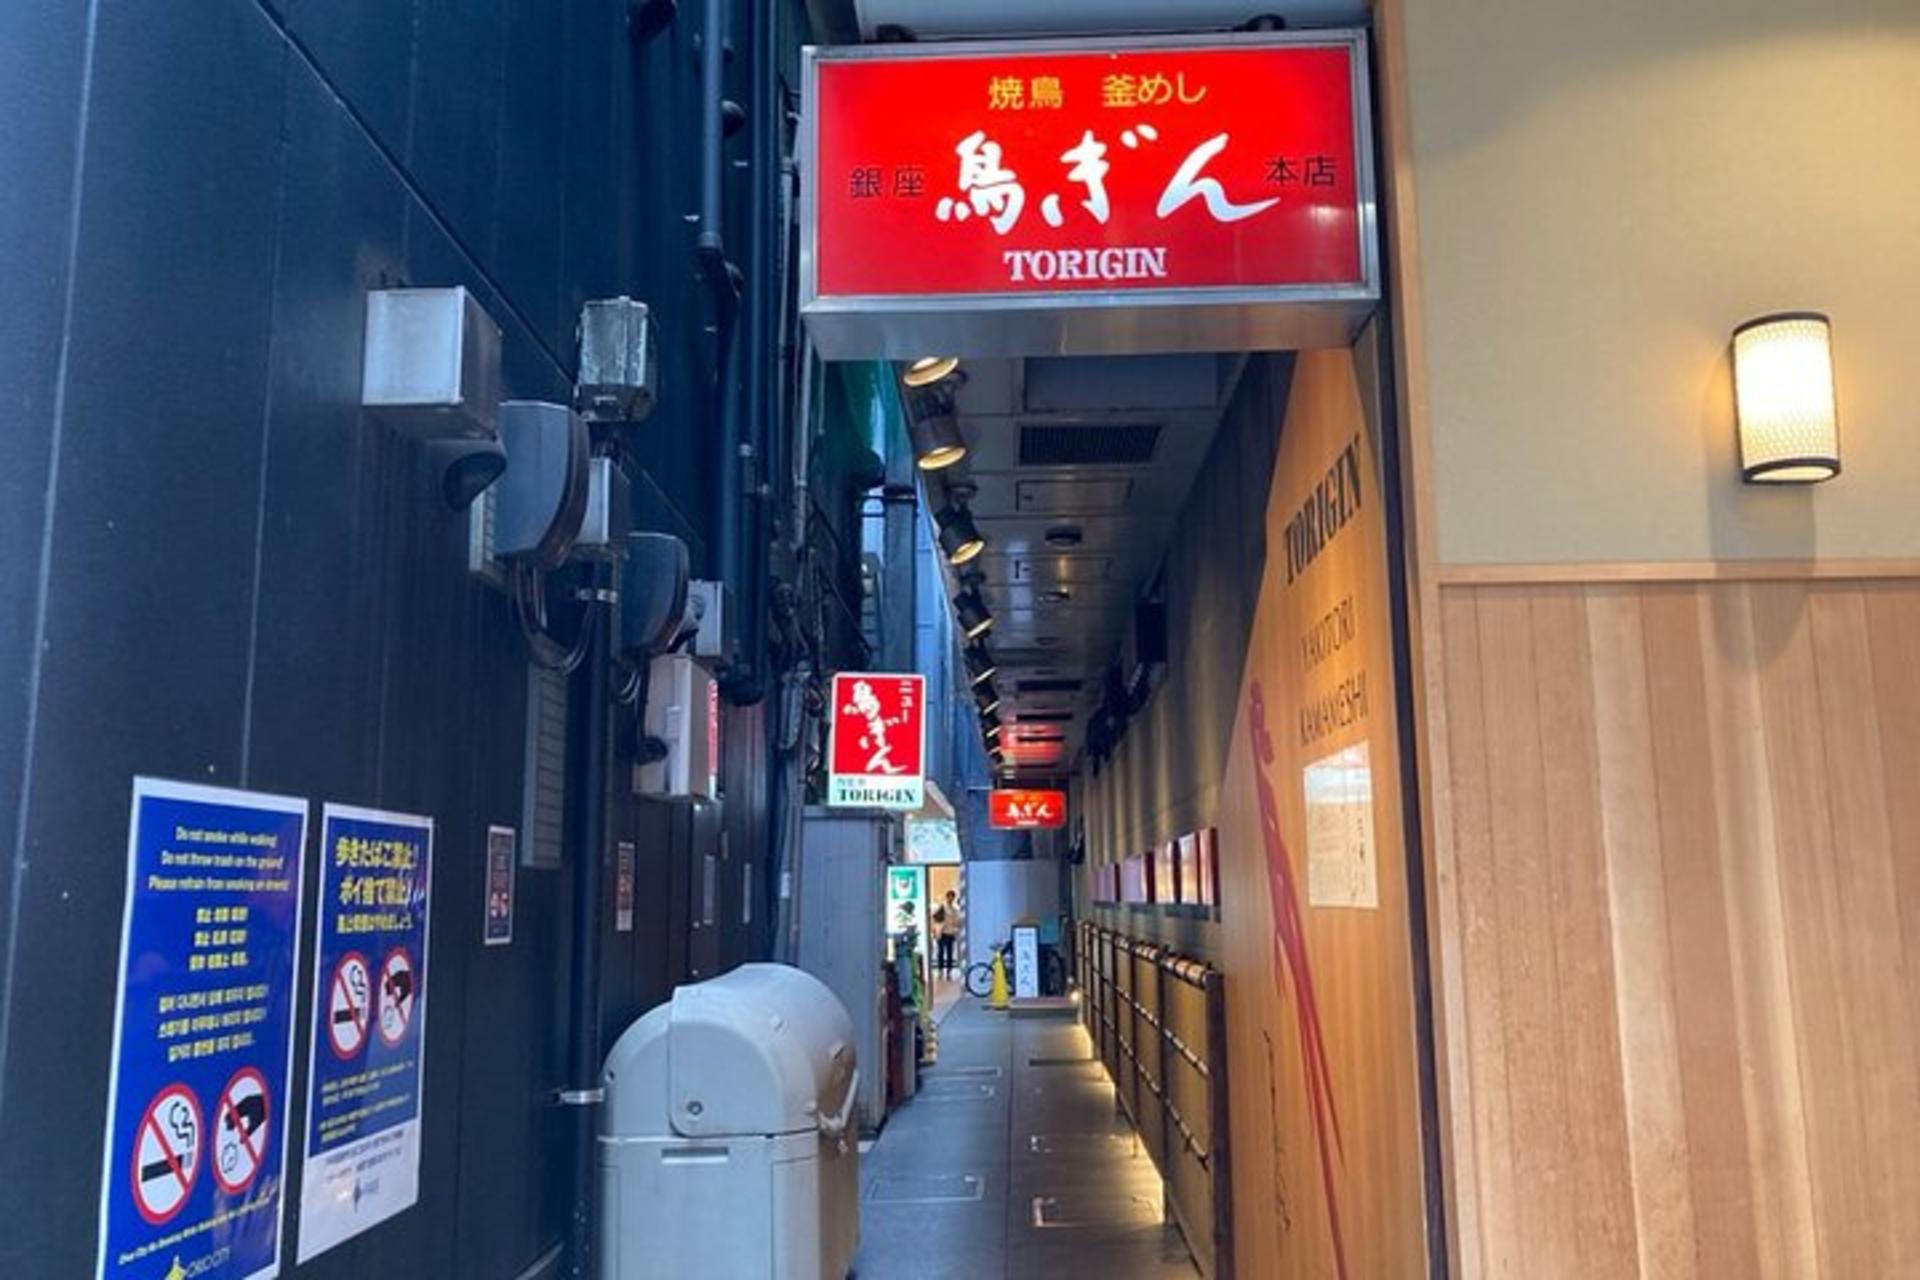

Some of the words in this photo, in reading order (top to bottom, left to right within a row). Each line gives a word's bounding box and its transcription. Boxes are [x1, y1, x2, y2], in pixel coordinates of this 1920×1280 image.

[987, 76, 1063, 110] 焼鳥
[1102, 72, 1207, 109] 釜めし
[849, 167, 925, 197] 銀座
[935, 123, 1281, 236] 鳥ぎん
[1265, 156, 1337, 188] 本店
[1003, 247, 1167, 281] TORIGIN
[1284, 433, 1361, 586] TORIGIN
[843, 680, 908, 773] 鳥ぎん
[838, 789, 917, 802] TORIGIN
